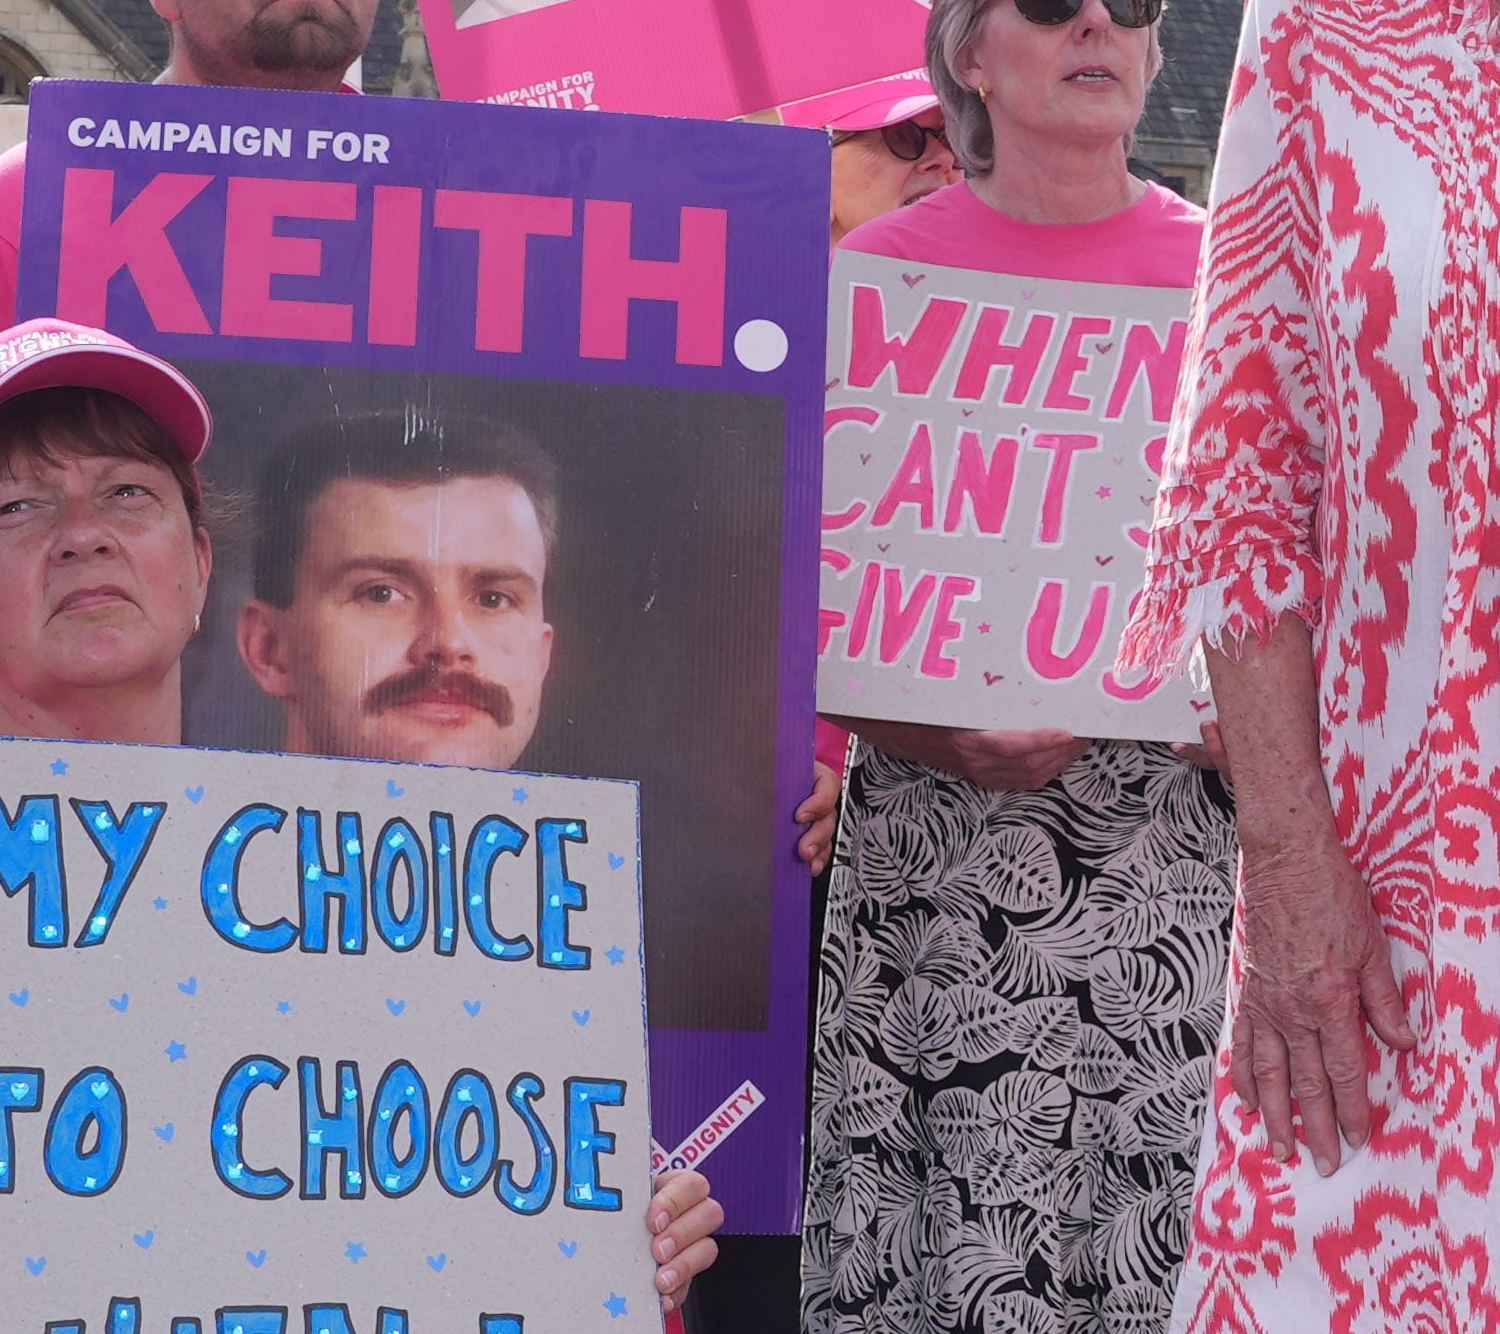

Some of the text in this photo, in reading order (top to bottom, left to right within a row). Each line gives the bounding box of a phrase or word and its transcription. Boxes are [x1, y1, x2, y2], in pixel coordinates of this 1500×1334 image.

[561, 71, 594, 88] FOR
[67, 117, 391, 165] CAMPAIGN FOR
[55, 167, 789, 373] KEITH.
[200, 803, 592, 970] CHOICE
[211, 1054, 626, 1216] CHOOSE
[681, 1087, 755, 1163] DIGNITY
